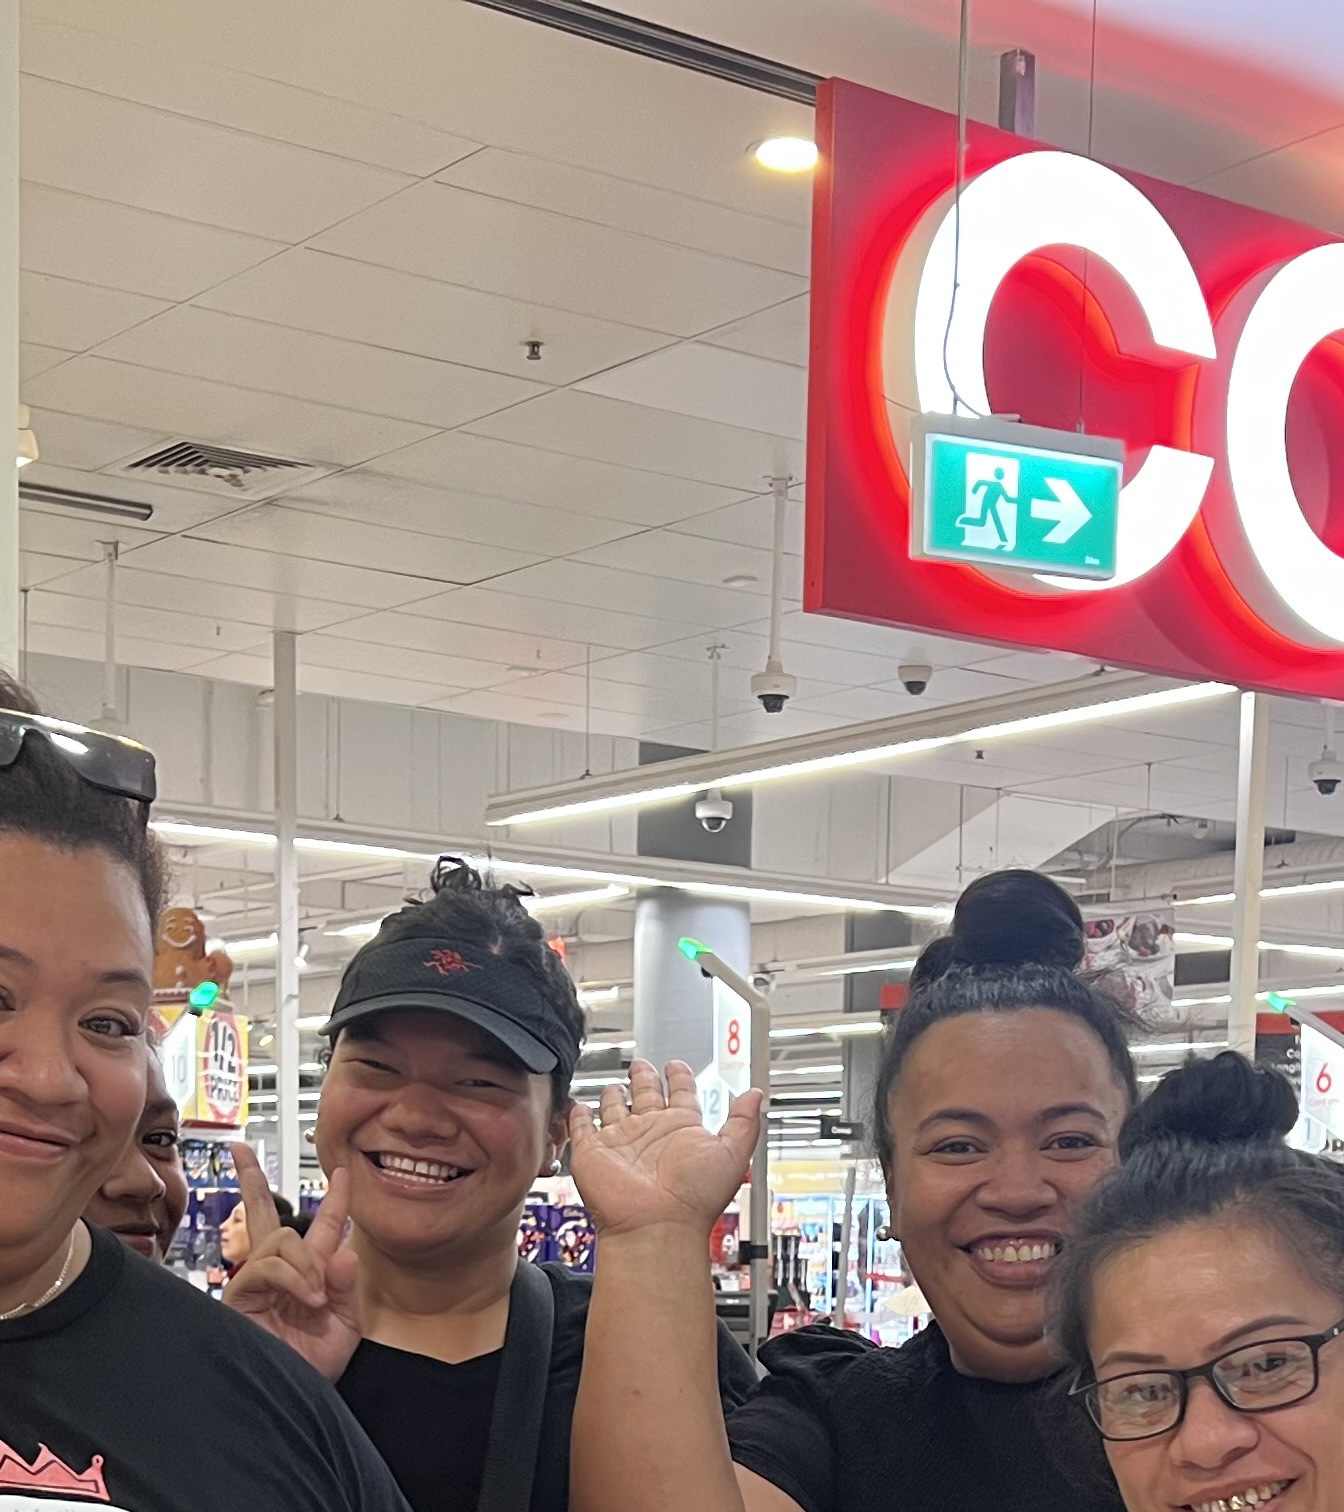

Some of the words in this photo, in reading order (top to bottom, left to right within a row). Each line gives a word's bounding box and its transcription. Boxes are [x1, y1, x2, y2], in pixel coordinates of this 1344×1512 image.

[728, 1019, 740, 1055] 8
[171, 1053, 187, 1085] 10
[1316, 1063, 1332, 1093] 6
